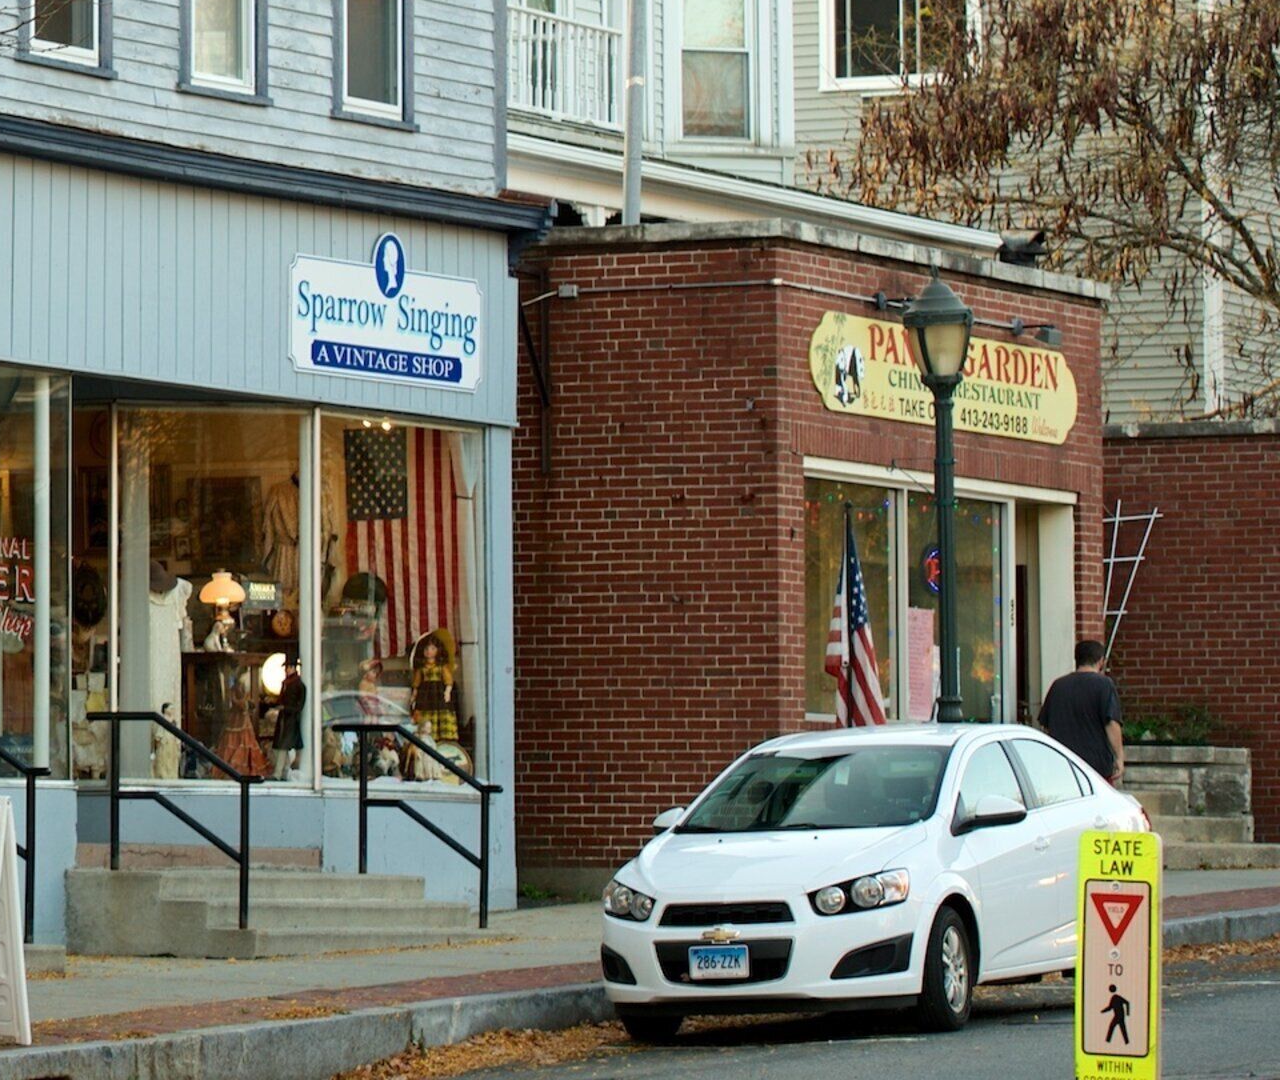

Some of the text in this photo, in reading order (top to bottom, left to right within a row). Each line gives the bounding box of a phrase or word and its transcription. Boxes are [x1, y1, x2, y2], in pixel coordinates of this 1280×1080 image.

[298, 280, 477, 356] Sparrow Singing
[317, 345, 453, 377] A VINTAGE SHOP
[868, 324, 1058, 392] PAN GARDEN
[888, 369, 1041, 410] CHIN RESTAURANT
[899, 397, 925, 419] TAKE
[960, 407, 1027, 435] 413-243-9188
[1094, 839, 1143, 856] STATE
[1100, 860, 1133, 875] LAW
[1107, 905, 1125, 914] YIELD
[1107, 963, 1123, 976] TO
[1096, 1060, 1133, 1073] WITHIN
